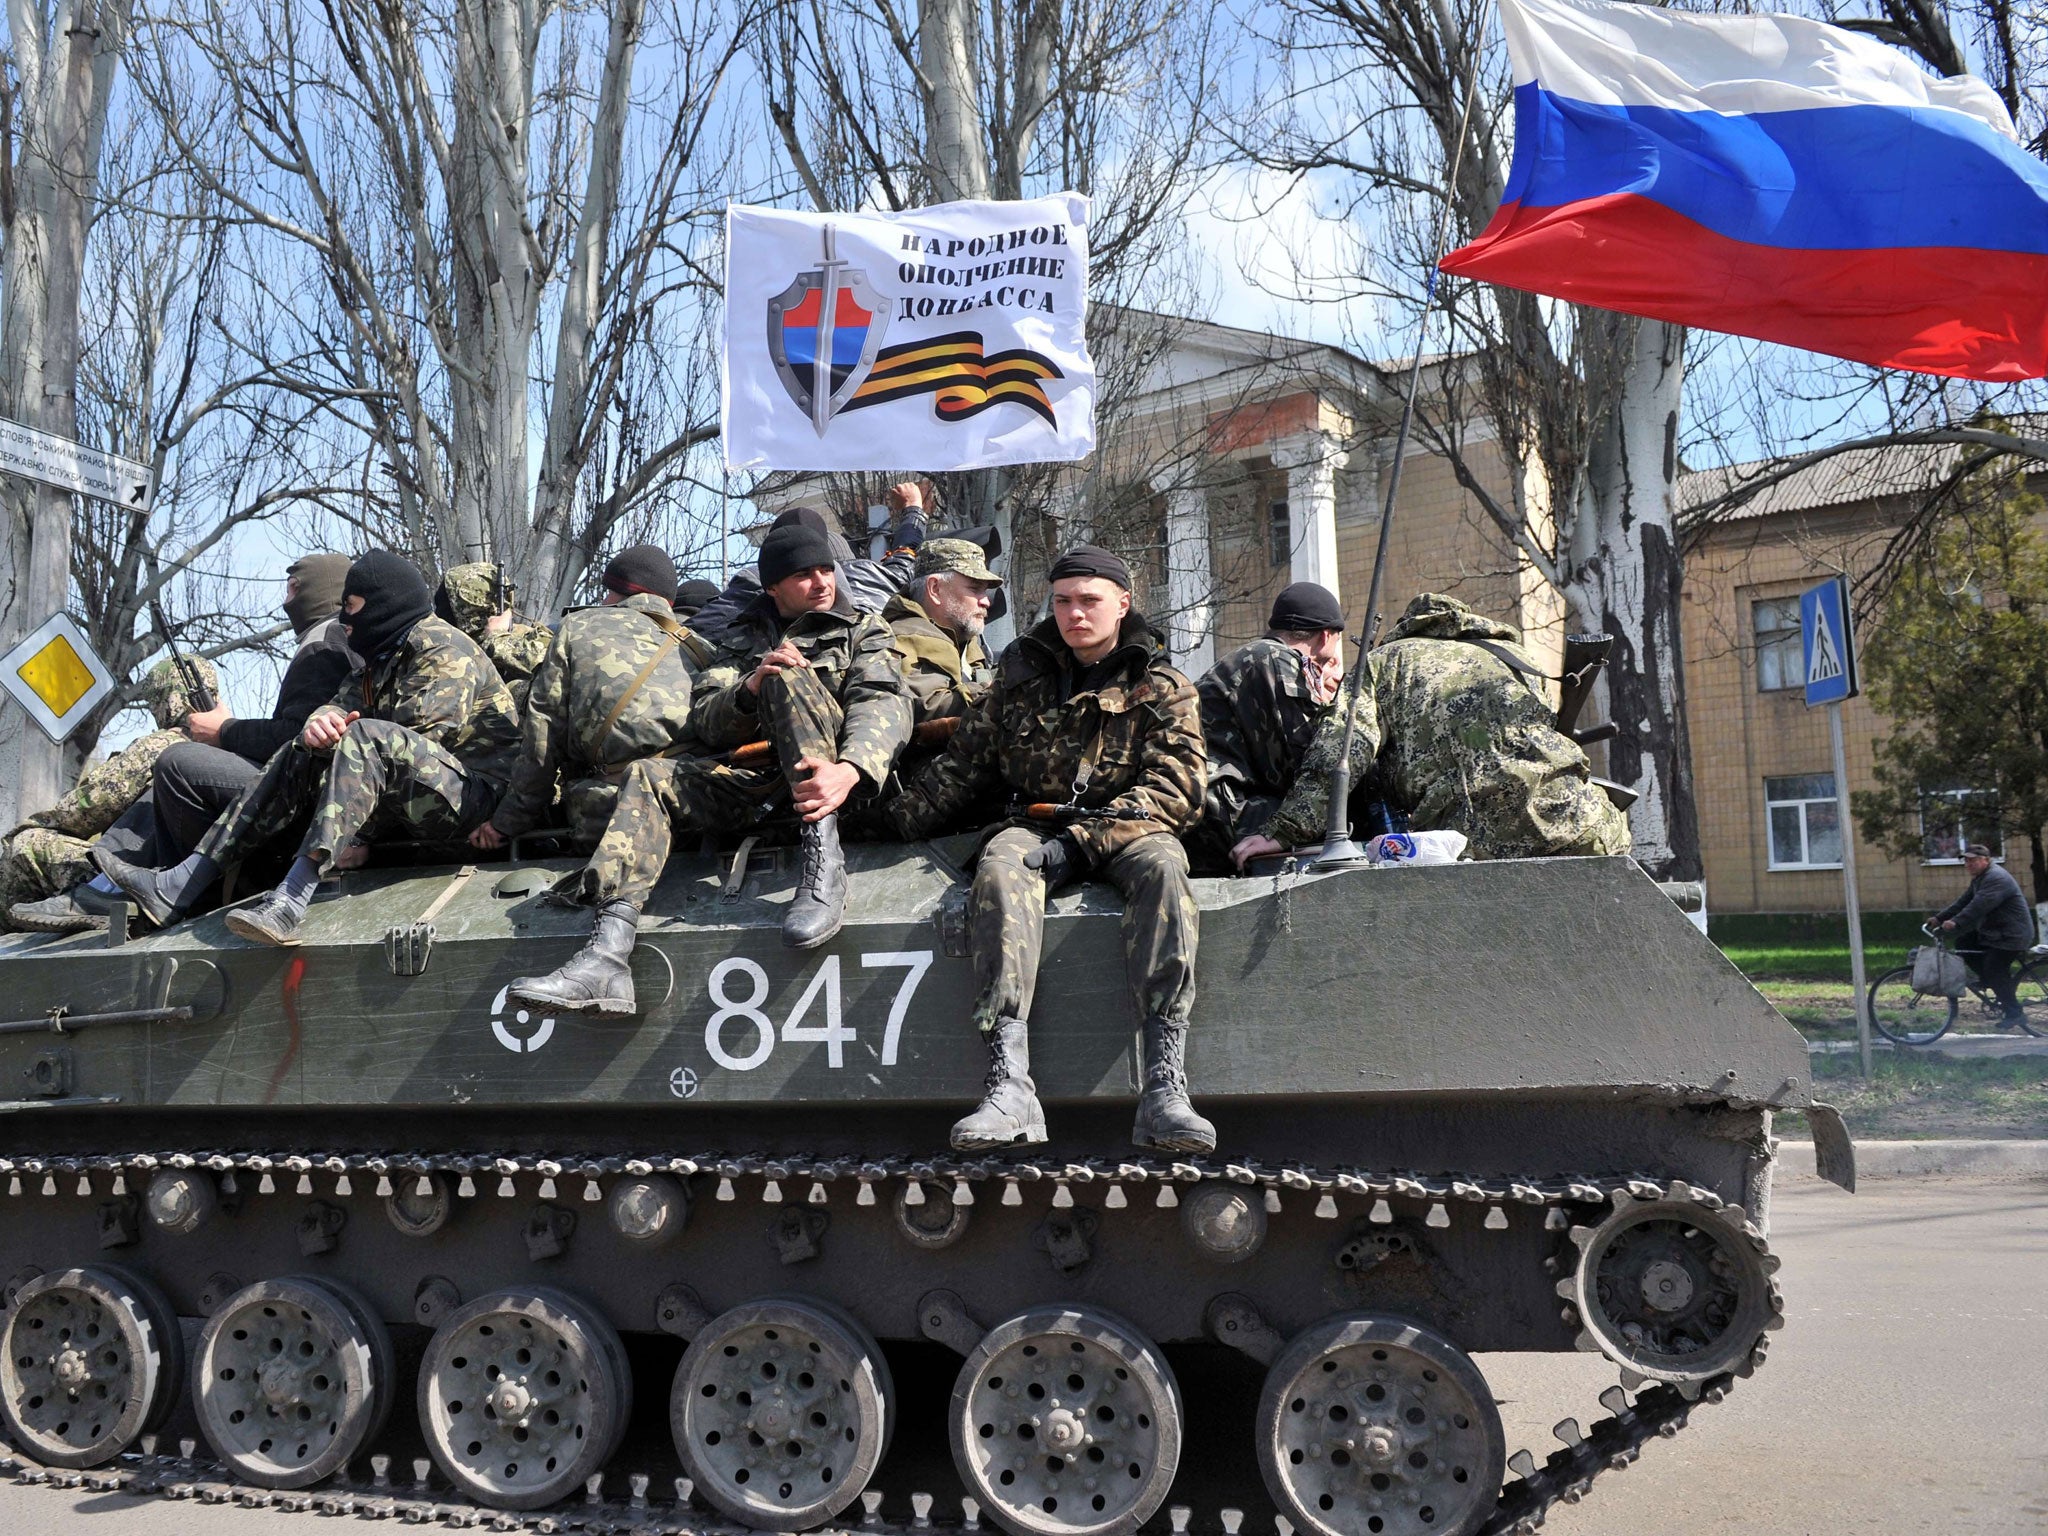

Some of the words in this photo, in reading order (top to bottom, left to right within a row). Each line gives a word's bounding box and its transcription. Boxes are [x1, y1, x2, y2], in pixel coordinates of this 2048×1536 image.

[901, 224, 1067, 257] НАРОДНОЕ
[899, 256, 1065, 287] ОПОЛЧЕНИЕ
[898, 286, 1054, 322] ДОНБАССА
[49, 465, 82, 483] СЛУЖБИ
[83, 476, 117, 494] ОХОРОНИ
[705, 950, 934, 1071] 847
